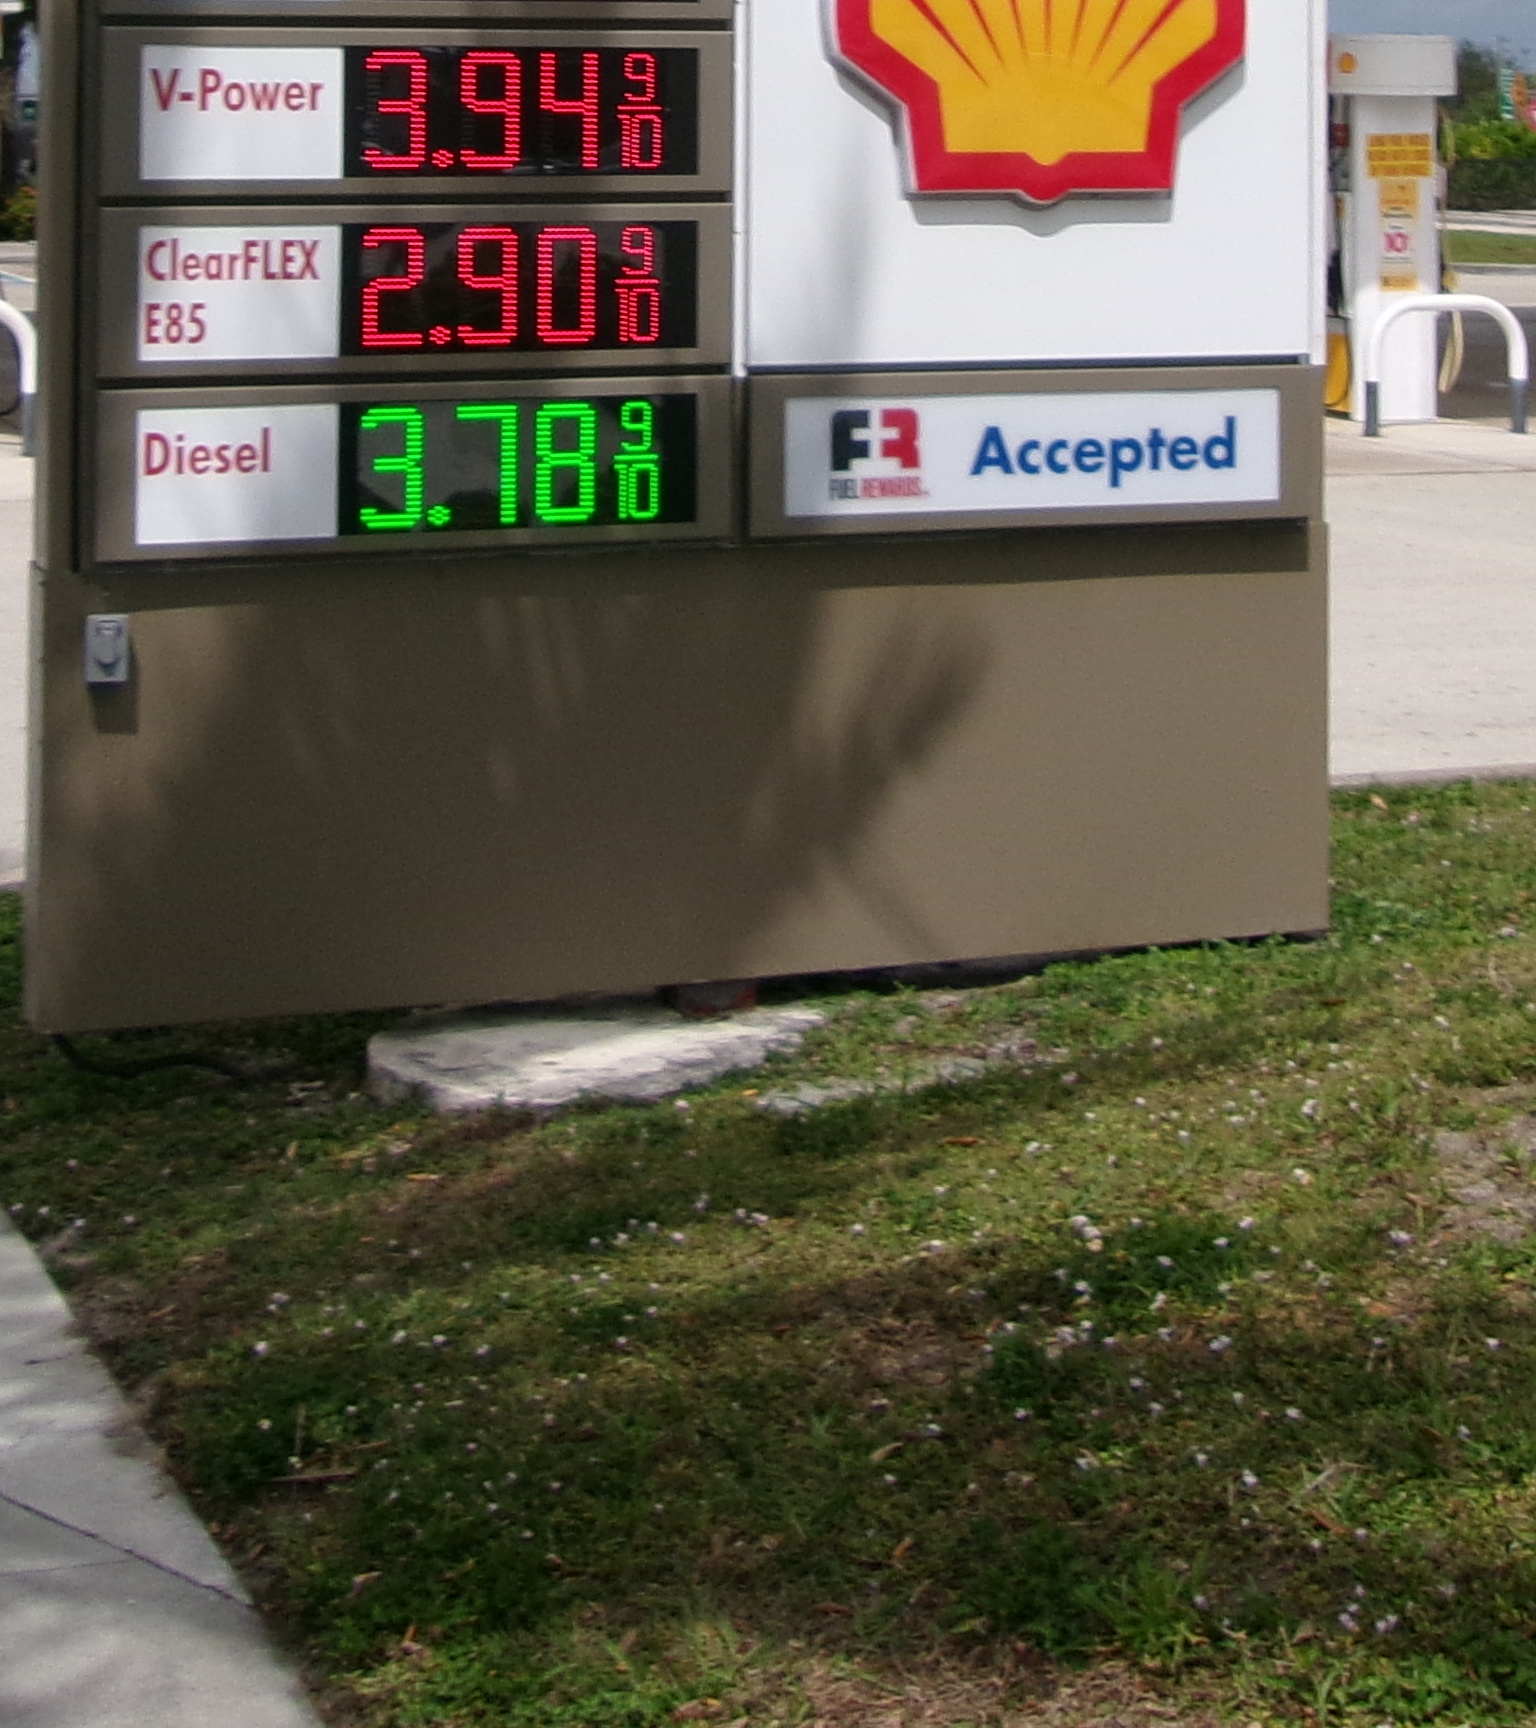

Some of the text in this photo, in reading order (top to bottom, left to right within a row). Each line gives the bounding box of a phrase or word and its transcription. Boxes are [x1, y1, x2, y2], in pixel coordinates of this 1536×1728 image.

[153, 68, 323, 112] V-Power
[362, 50, 600, 170] 3.94
[146, 238, 318, 281] ClearFLEX
[361, 226, 597, 348] 2.90
[144, 302, 207, 345] E85
[143, 428, 272, 477] Diesel
[359, 402, 599, 530] 3.78
[970, 415, 1237, 489] Accepted
